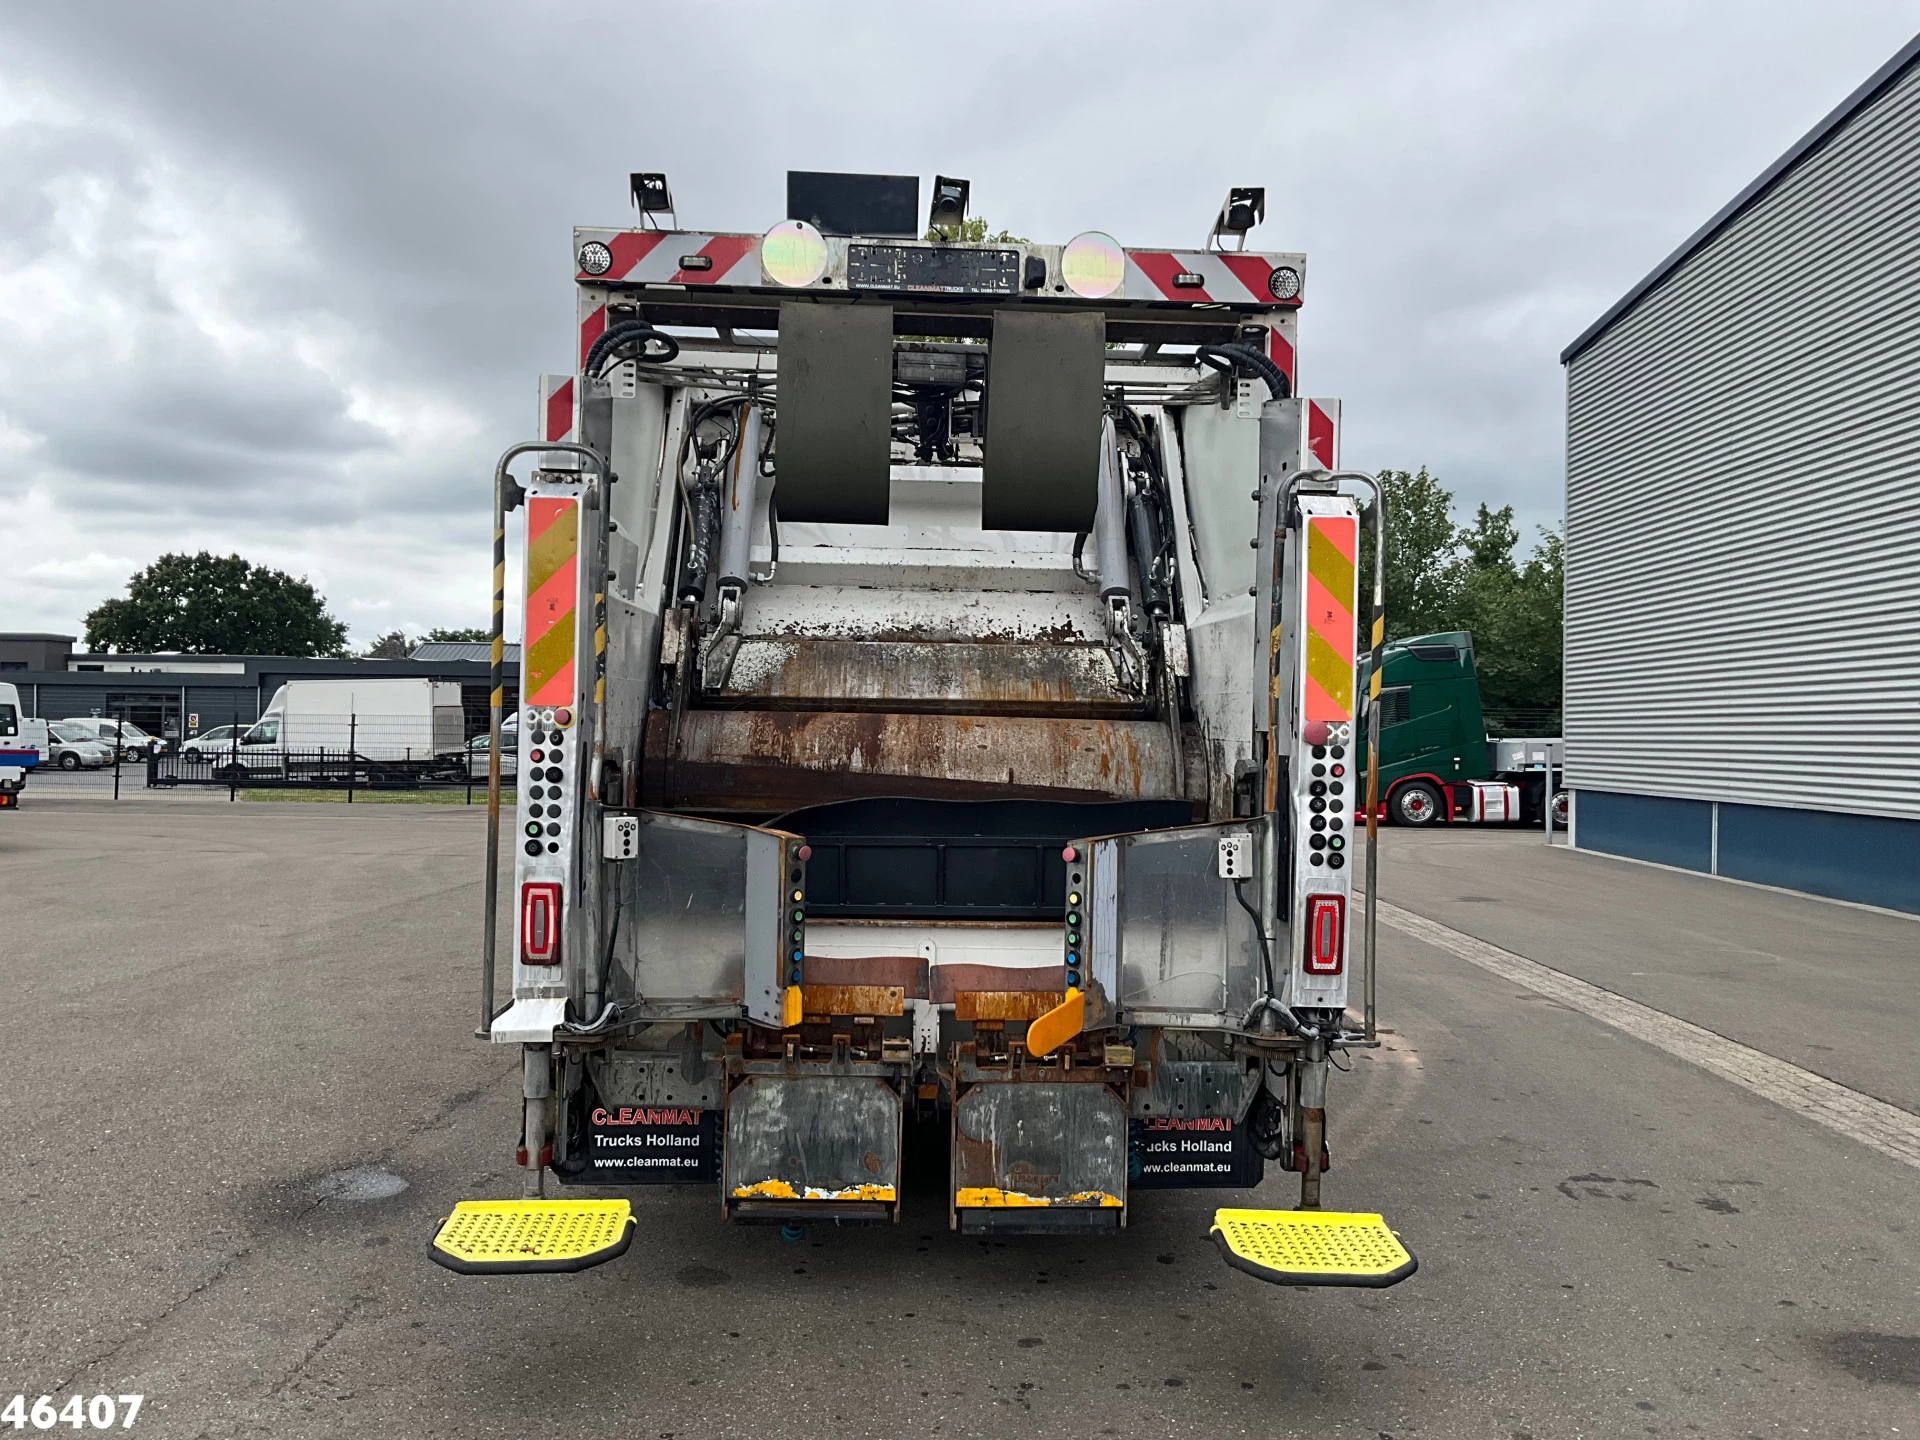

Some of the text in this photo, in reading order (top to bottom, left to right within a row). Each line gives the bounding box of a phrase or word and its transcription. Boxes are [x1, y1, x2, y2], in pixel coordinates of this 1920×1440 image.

[592, 1108, 703, 1125] CLEANMAT
[1143, 1117, 1232, 1131] LEANMAT
[595, 1134, 700, 1147] Trucks Holland
[1181, 1140, 1232, 1152] Holland
[594, 1156, 699, 1167] www.cleanmat.eu
[1143, 1162, 1231, 1173] ww.cleanmat.eu
